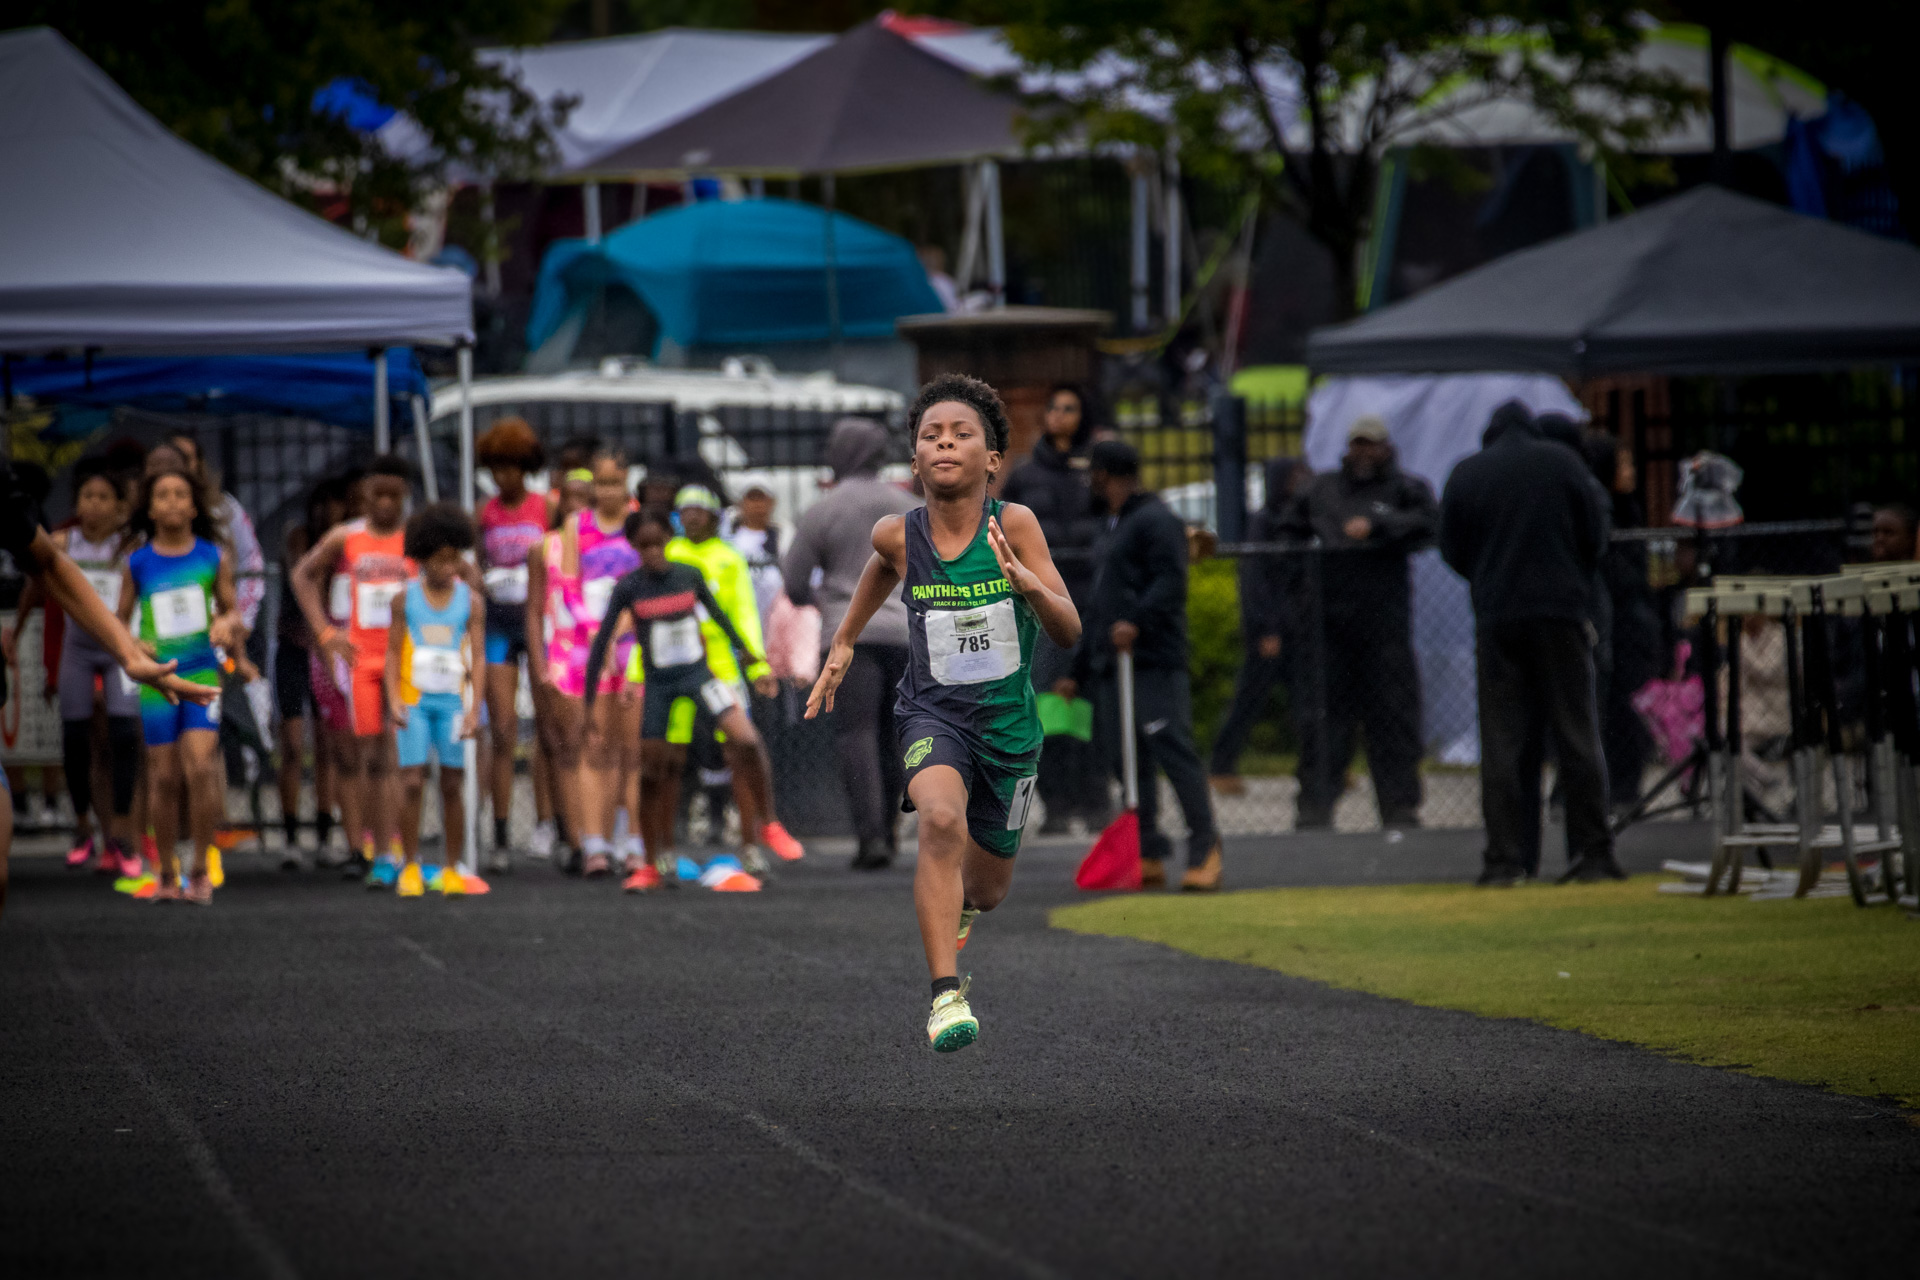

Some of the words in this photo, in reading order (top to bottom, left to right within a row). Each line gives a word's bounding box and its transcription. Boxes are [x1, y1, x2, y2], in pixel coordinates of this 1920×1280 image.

[973, 578, 1010, 596] ELITE
[972, 599, 987, 607] CLUB
[957, 634, 990, 654] 785
[1020, 780, 1031, 825] 1
